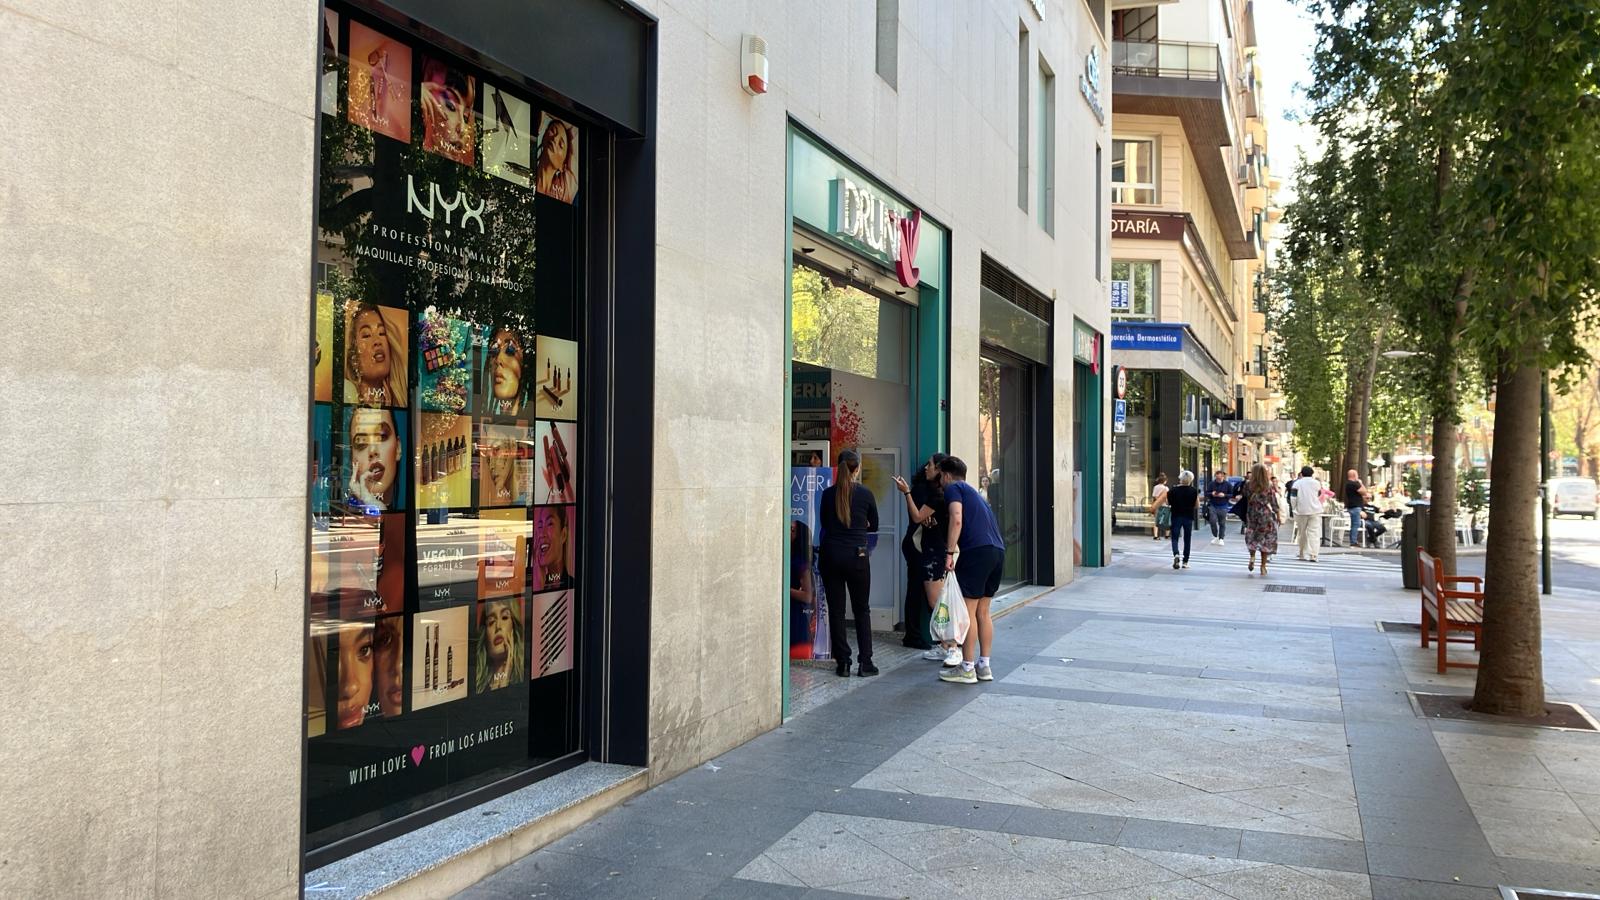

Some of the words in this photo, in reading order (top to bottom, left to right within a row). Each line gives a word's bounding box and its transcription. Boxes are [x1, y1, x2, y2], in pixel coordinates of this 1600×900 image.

[407, 174, 485, 234] NYX
[373, 224, 464, 258] PROFESSIONAL
[470, 252, 511, 269] MAKEUP
[355, 244, 414, 267] MAQUILLAJE
[417, 258, 474, 281] PROFESIONAL
[476, 271, 495, 286] PARA
[498, 278, 524, 293] TODOS
[368, 388, 386, 397] NYX
[499, 399, 512, 408] NYX
[497, 490, 511, 498] NYX
[422, 561, 463, 573] FORMULAS
[548, 574, 561, 582] NYX
[495, 580, 510, 590] NYX
[434, 588, 450, 598] NYX
[364, 597, 382, 608] NYX
[493, 672, 508, 681] NYX
[362, 702, 380, 714] NYX
[349, 763, 377, 785] WITH
[381, 754, 407, 775] LOVE
[429, 739, 455, 760] FROM
[459, 733, 474, 750] LOS
[477, 721, 514, 744] ANGELES
